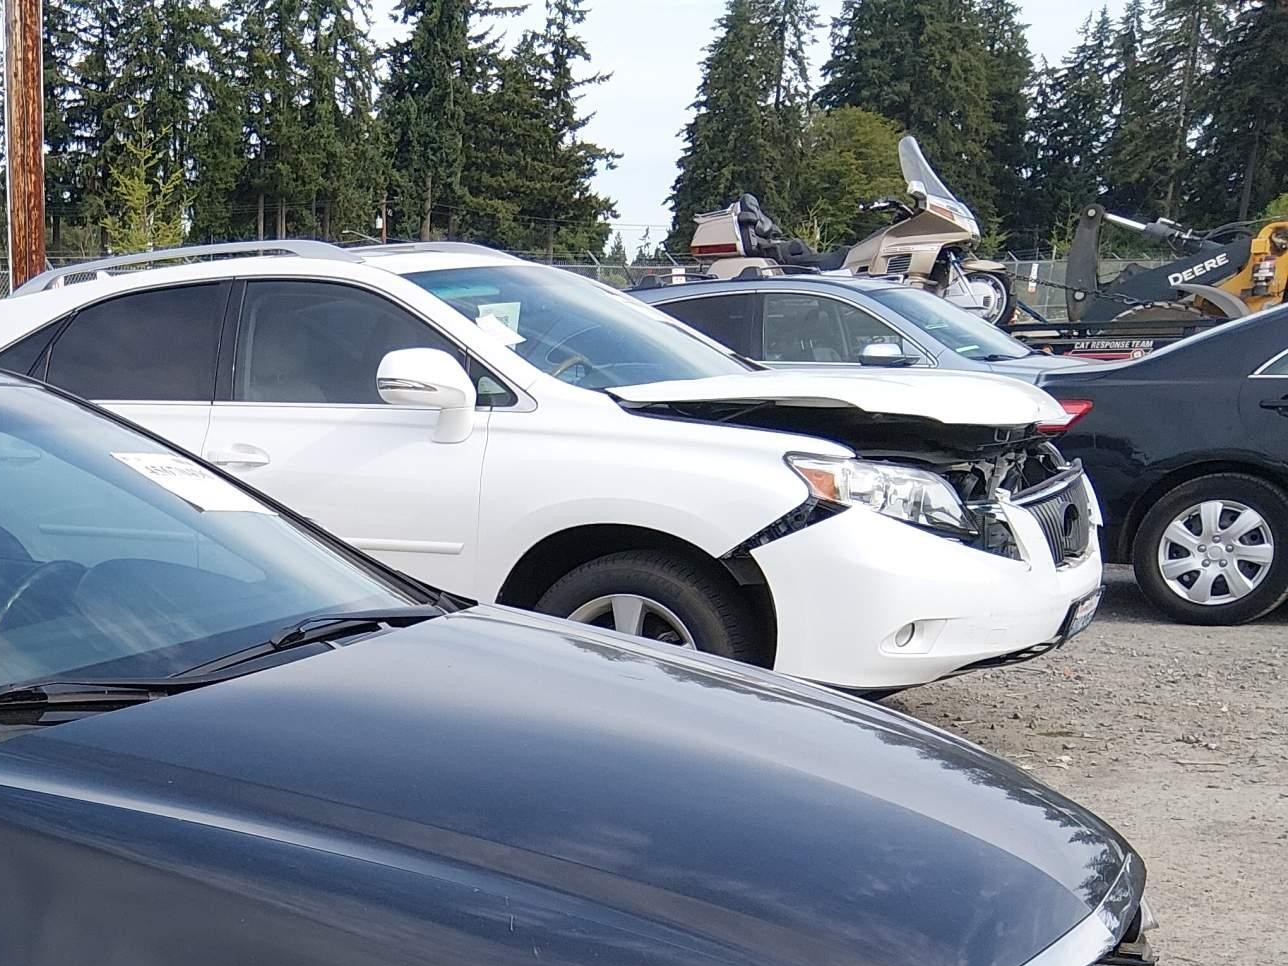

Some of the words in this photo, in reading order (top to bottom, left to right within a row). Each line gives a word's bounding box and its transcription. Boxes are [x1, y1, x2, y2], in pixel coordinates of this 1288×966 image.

[1168, 253, 1229, 286] DEERE
[1074, 341, 1090, 349] CAT
[1091, 341, 1130, 349] RESPONSE
[1131, 340, 1153, 348] TEAM
